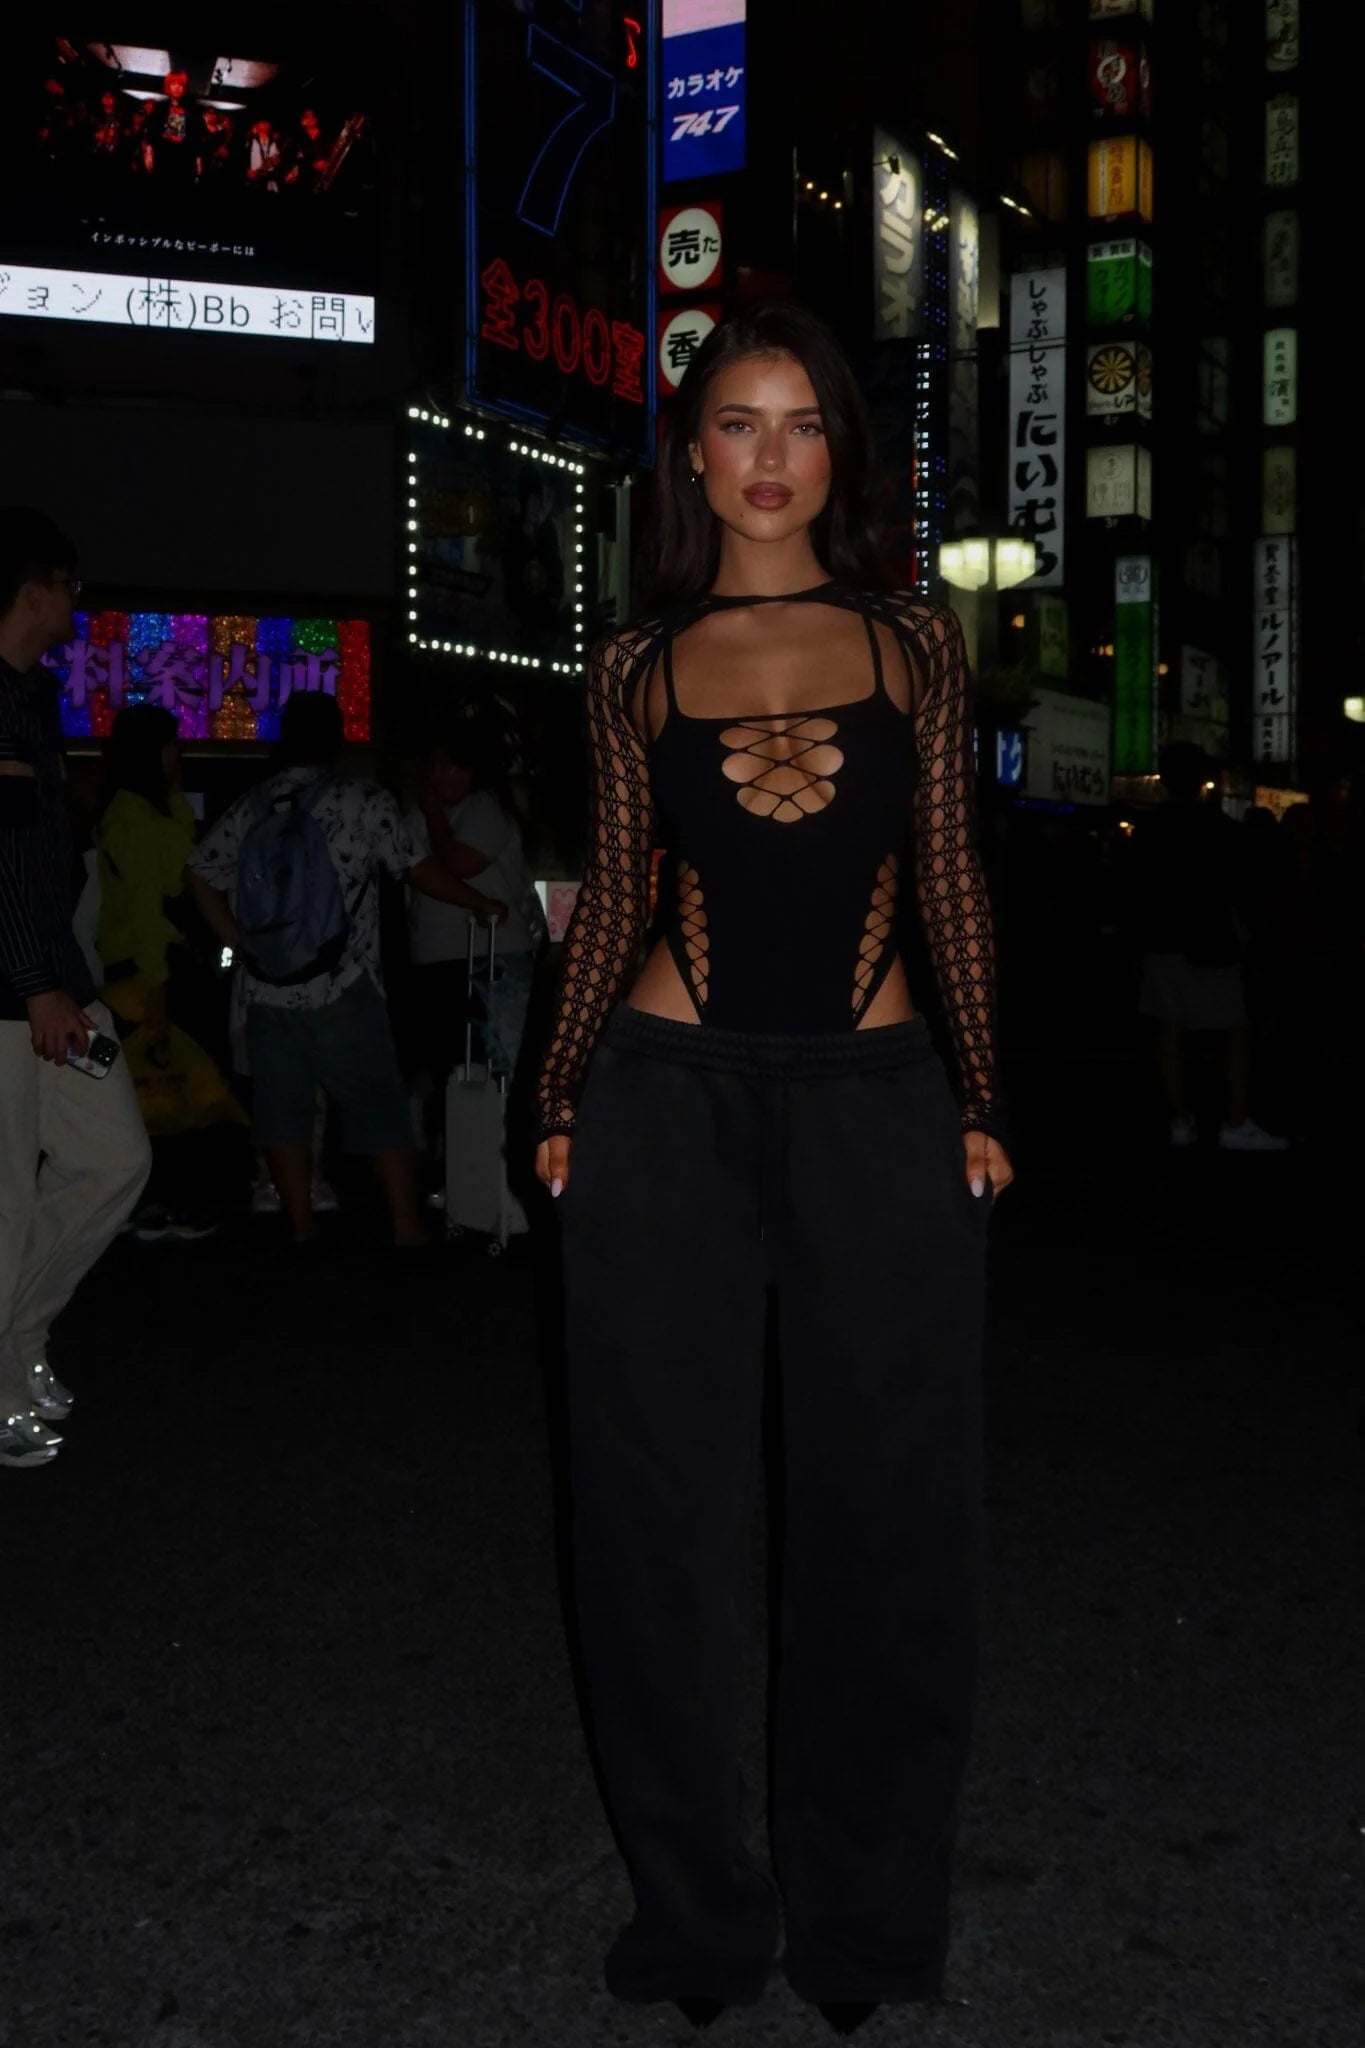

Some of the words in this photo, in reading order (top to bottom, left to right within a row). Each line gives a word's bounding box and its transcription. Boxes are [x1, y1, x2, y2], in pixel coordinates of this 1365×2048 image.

[668, 67, 744, 99] カラオケ
[670, 105, 740, 141] 747
[39, 638, 341, 711] 料案内所
